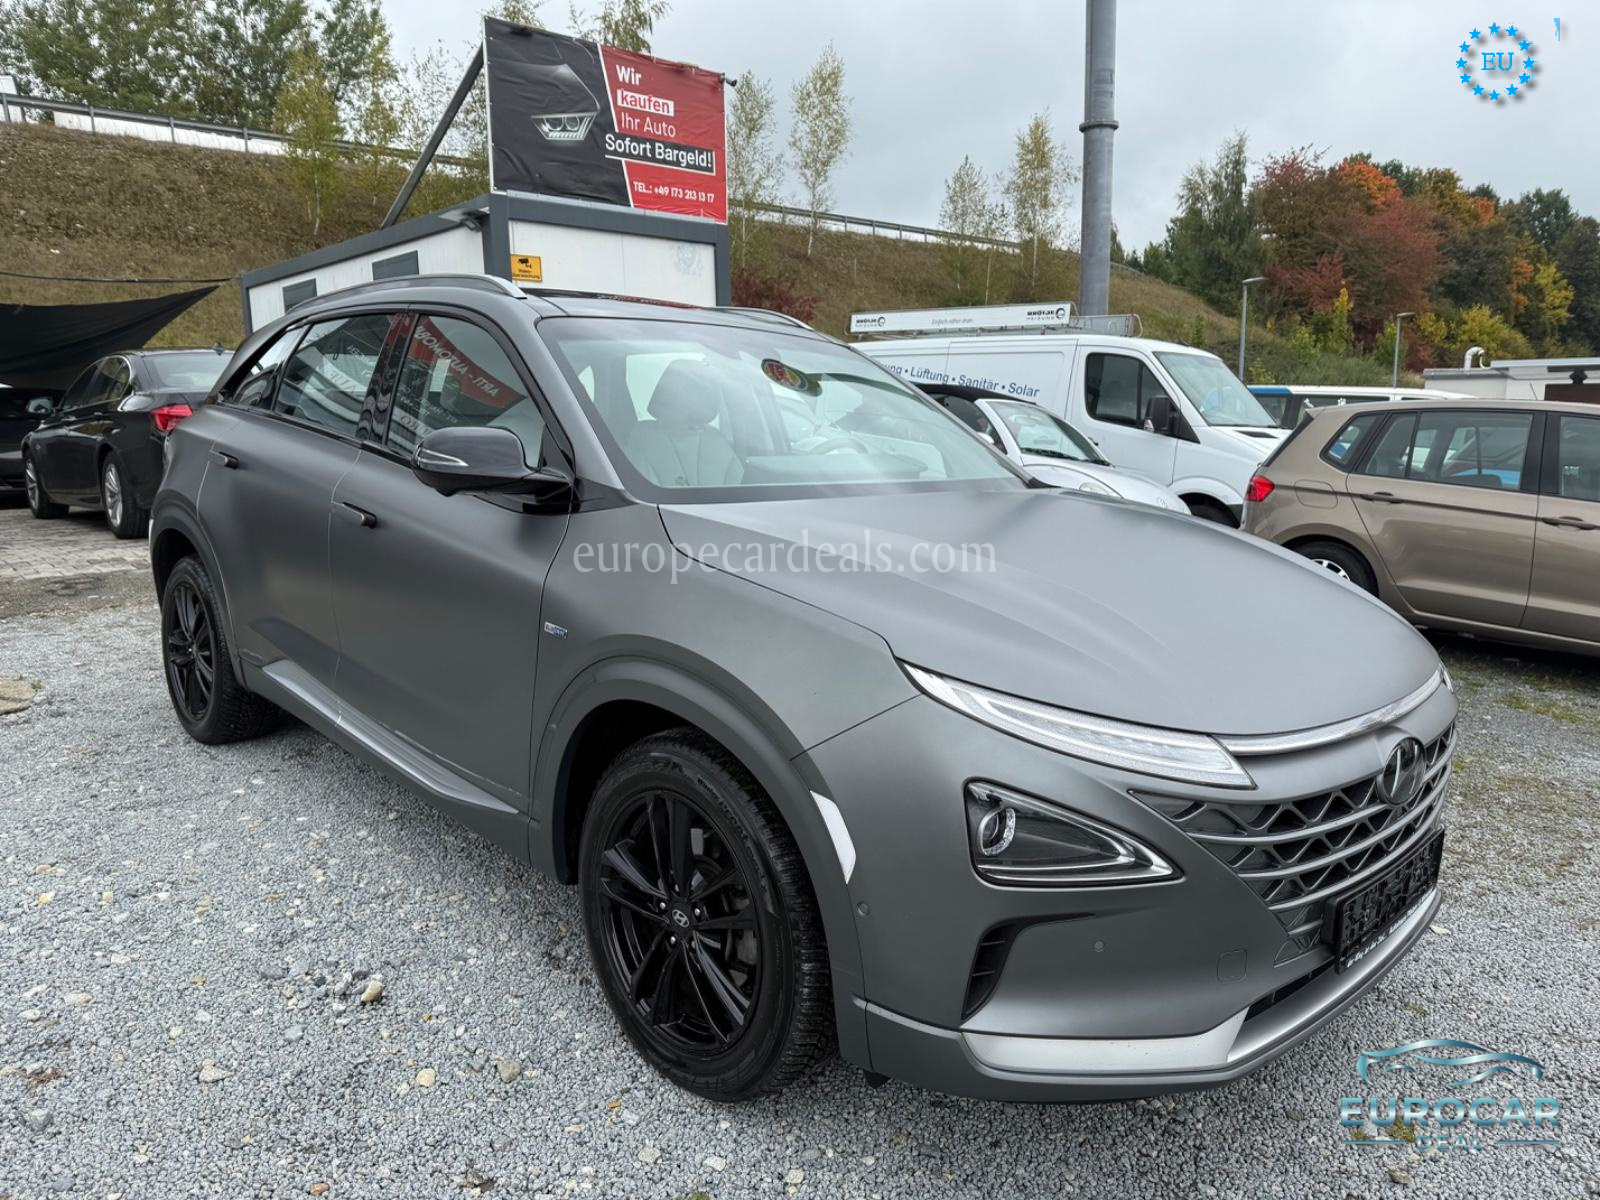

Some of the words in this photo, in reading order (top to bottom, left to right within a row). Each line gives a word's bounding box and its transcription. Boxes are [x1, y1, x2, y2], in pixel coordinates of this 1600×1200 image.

[616, 64, 642, 86] Wir
[621, 89, 670, 114] kaufen
[621, 111, 640, 131] Ihr
[643, 116, 676, 138] Auto
[605, 133, 652, 158] Sofort
[655, 142, 712, 168] Bargeld!
[654, 185, 669, 196] +49
[671, 187, 683, 198] 173
[685, 189, 697, 200] 213
[698, 191, 705, 201] 13
[707, 193, 715, 203] 17
[910, 366, 949, 384] Lüftung
[958, 374, 999, 391] Sanitär
[1007, 382, 1040, 398] Solar
